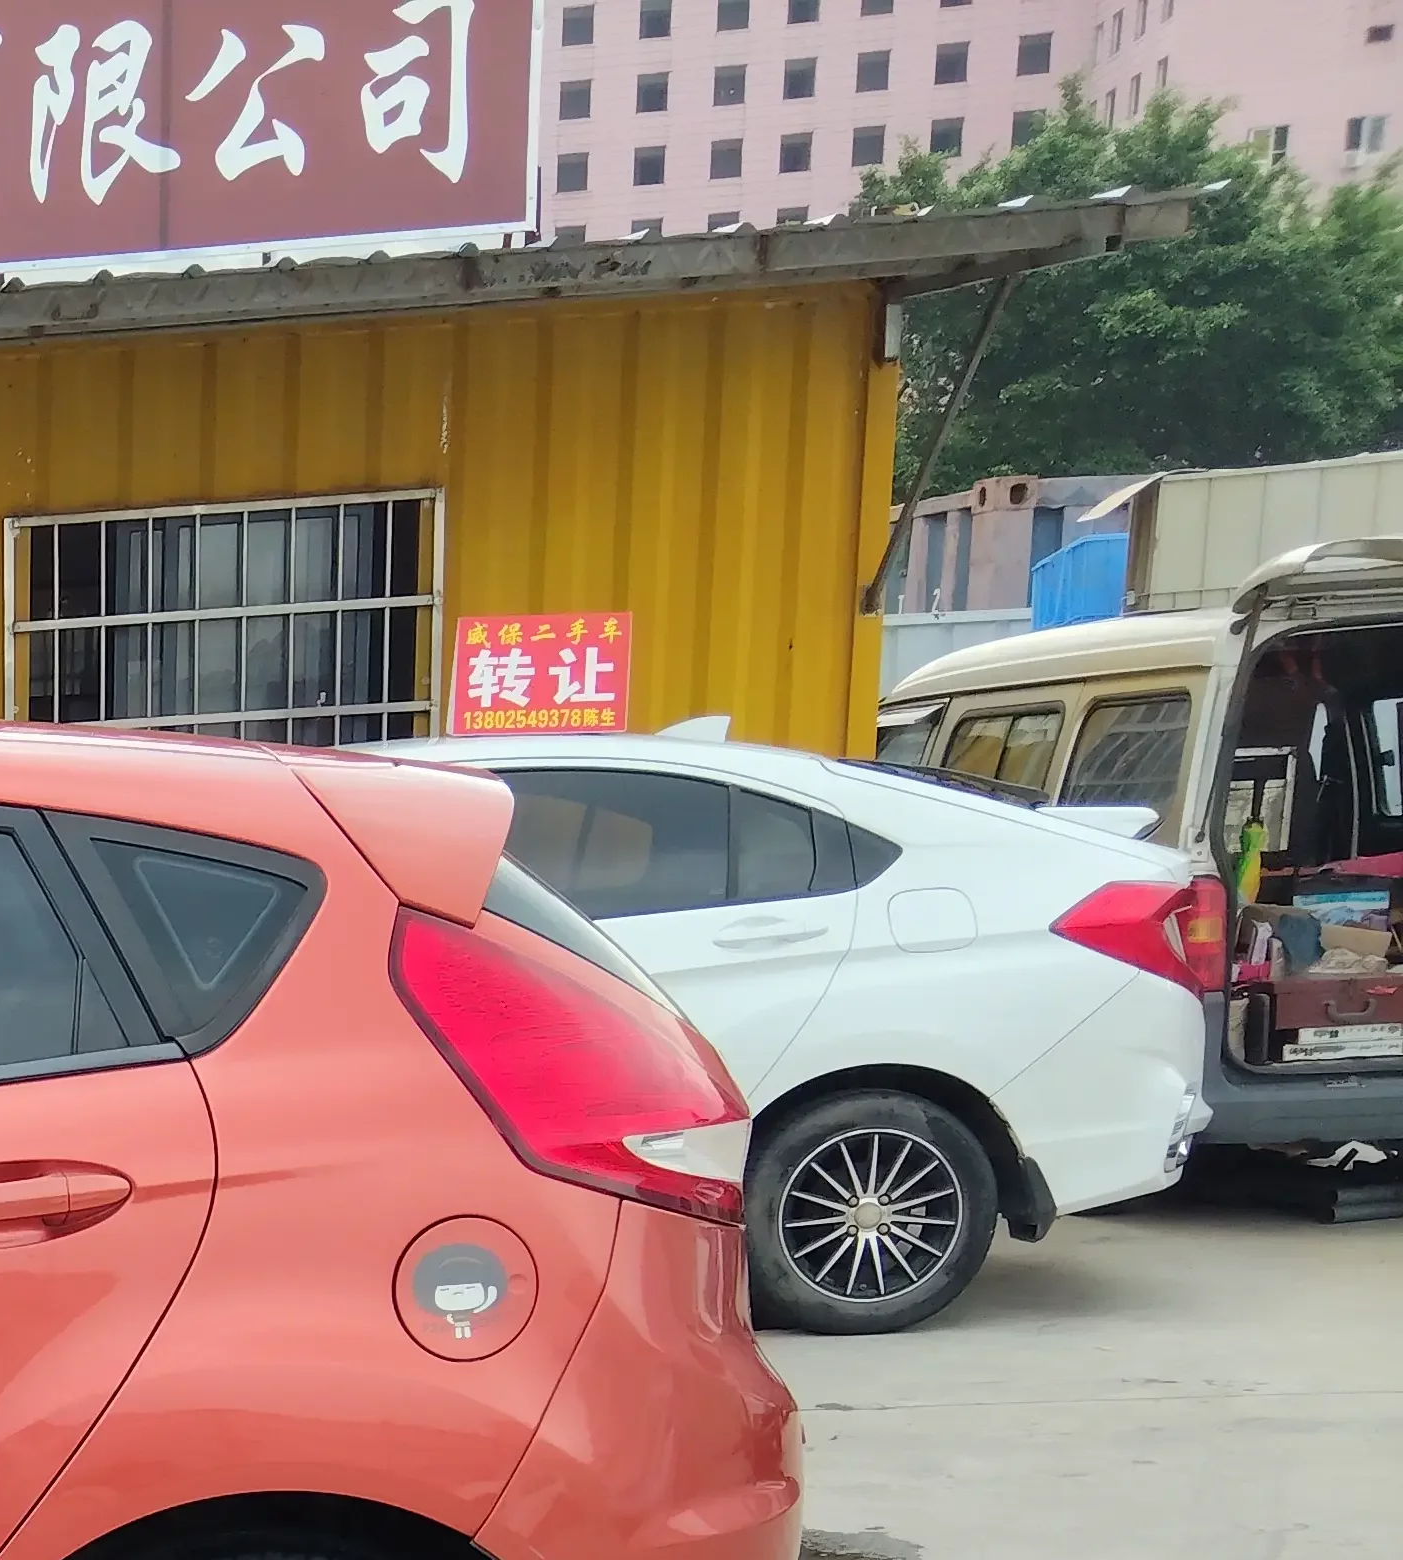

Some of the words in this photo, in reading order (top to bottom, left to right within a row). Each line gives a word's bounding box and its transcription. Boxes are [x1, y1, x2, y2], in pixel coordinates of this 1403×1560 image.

[465, 617, 623, 648] 威保二手车
[467, 647, 616, 708] 转让
